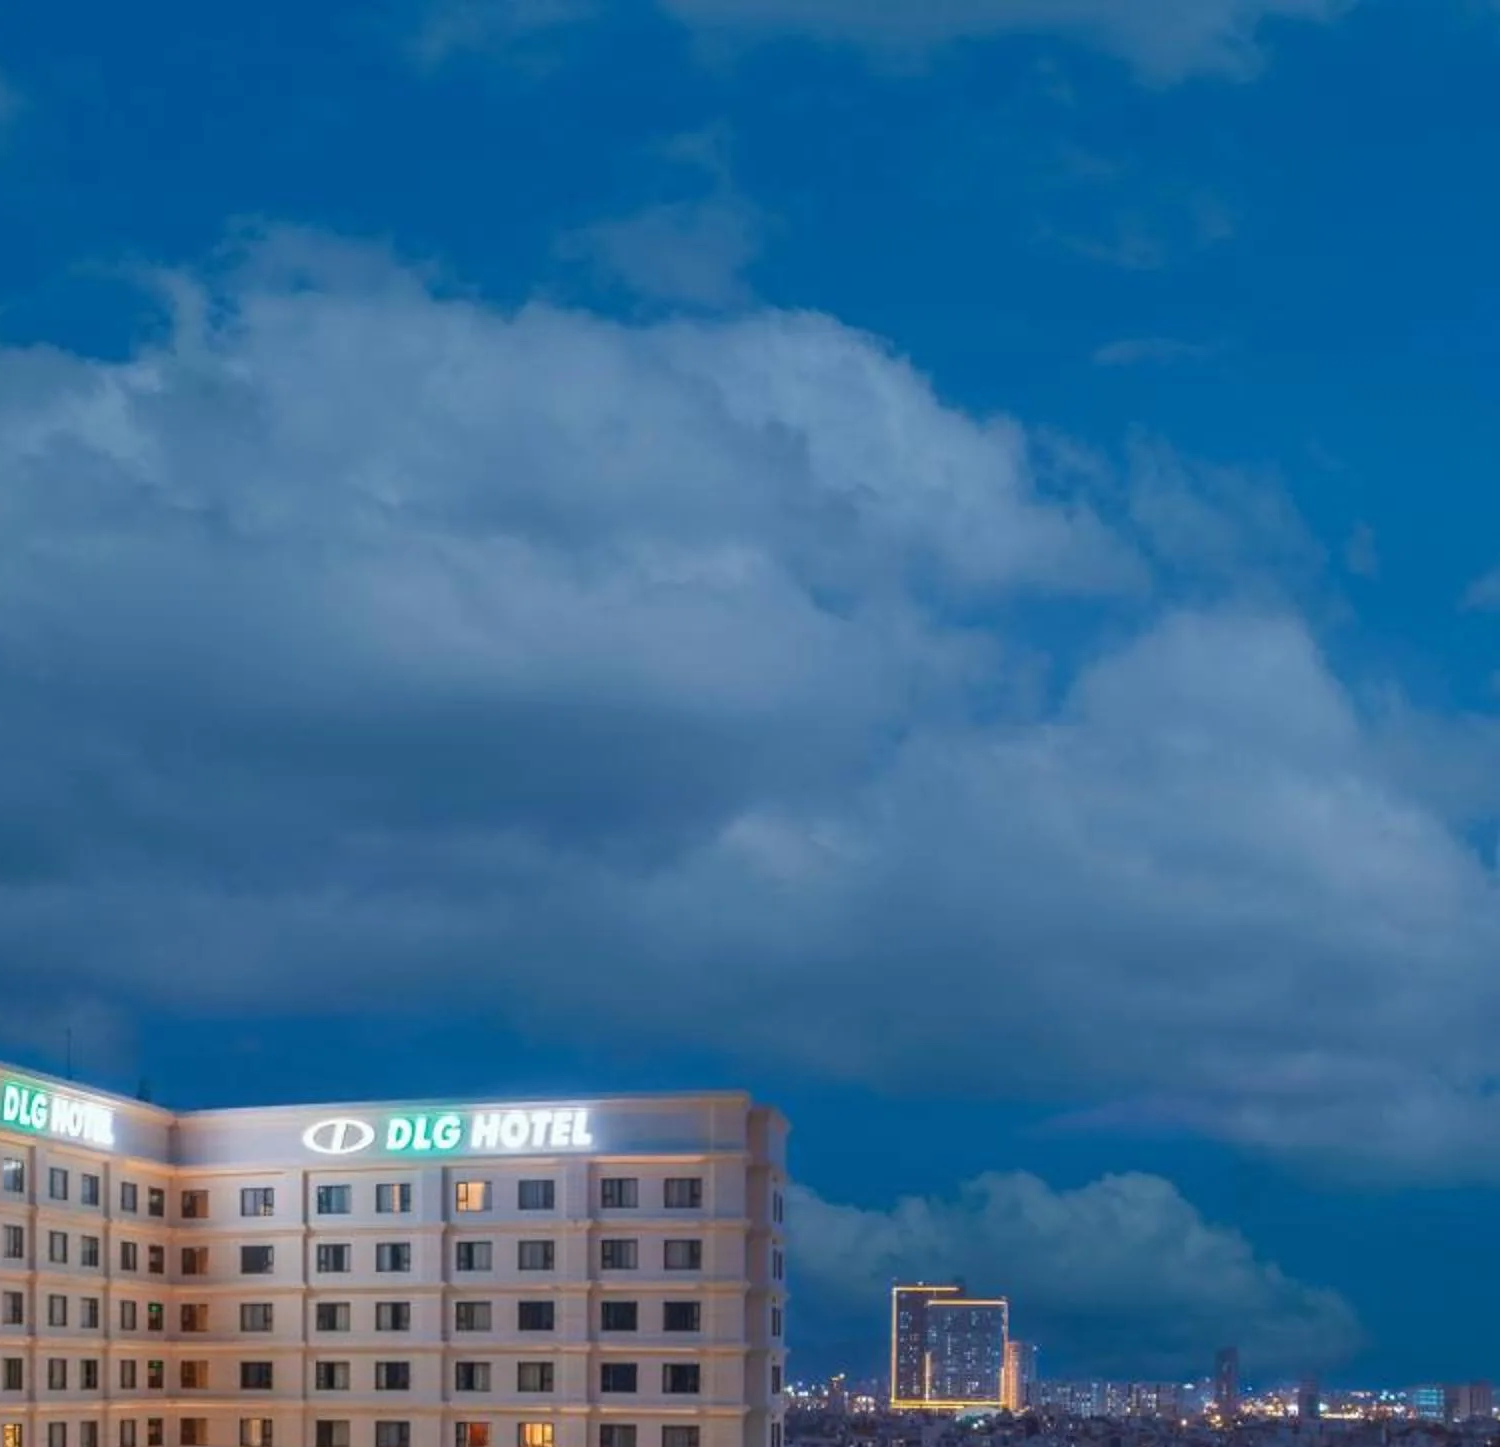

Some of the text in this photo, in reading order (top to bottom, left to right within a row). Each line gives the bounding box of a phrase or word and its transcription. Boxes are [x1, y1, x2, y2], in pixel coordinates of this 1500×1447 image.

[3, 1084, 49, 1130] DLG
[386, 1109, 593, 1150] DLG HOTEL
